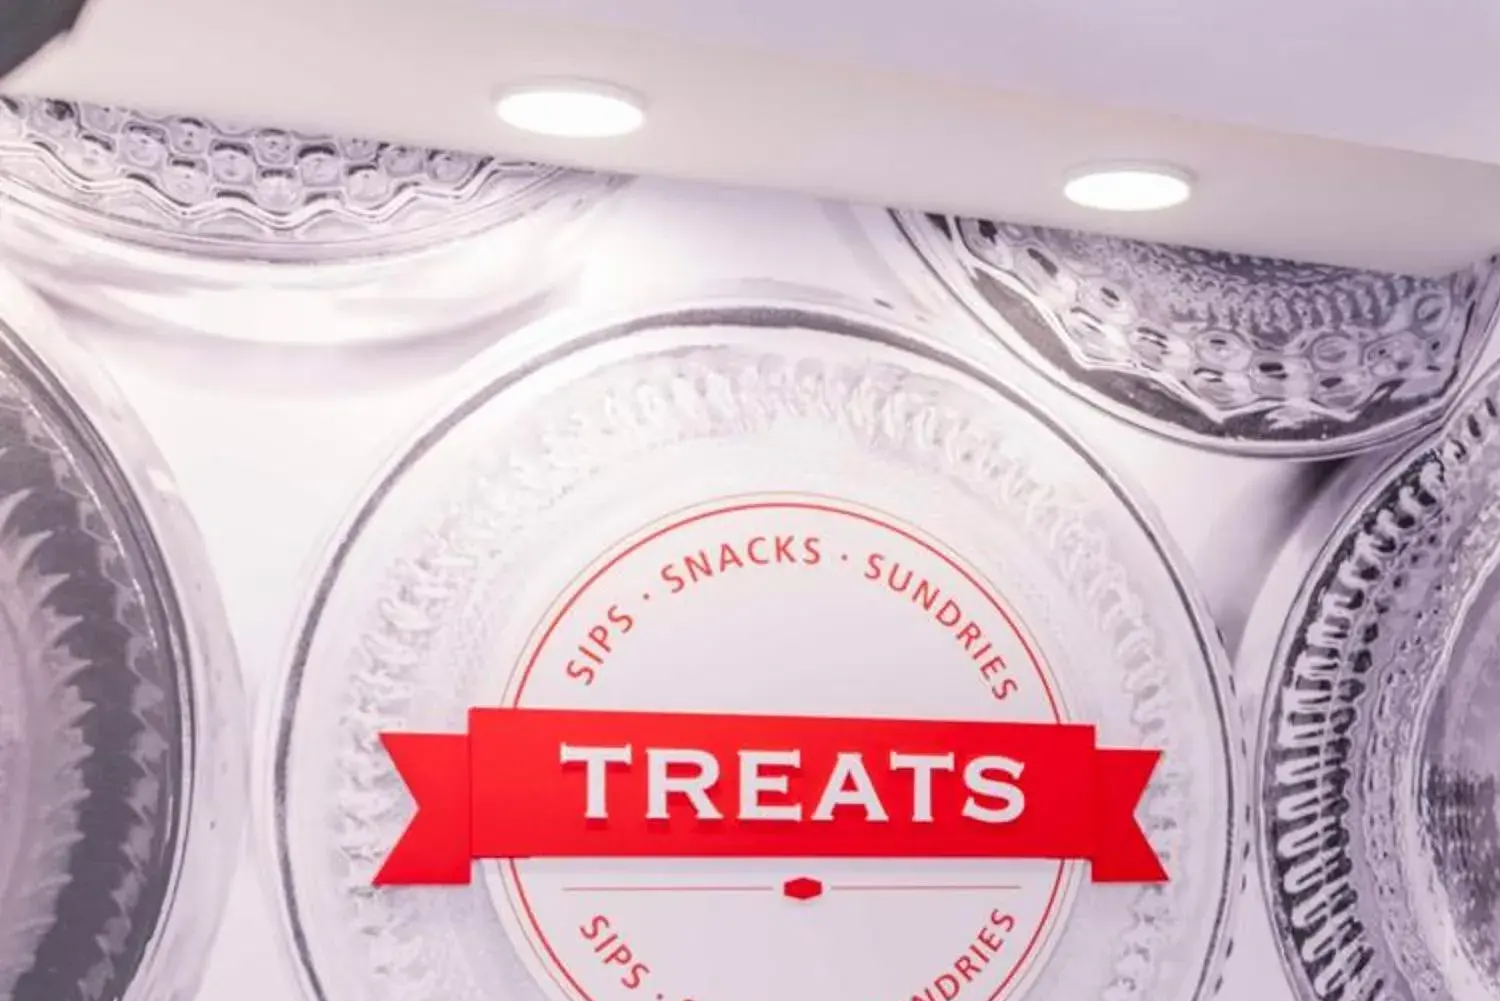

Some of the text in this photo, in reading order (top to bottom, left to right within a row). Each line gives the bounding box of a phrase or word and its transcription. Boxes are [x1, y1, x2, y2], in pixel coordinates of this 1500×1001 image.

[565, 534, 1020, 701] SIPS SNACKS SUNDRIES
[560, 743, 1028, 825] TREATS
[579, 913, 650, 993] SIPS
